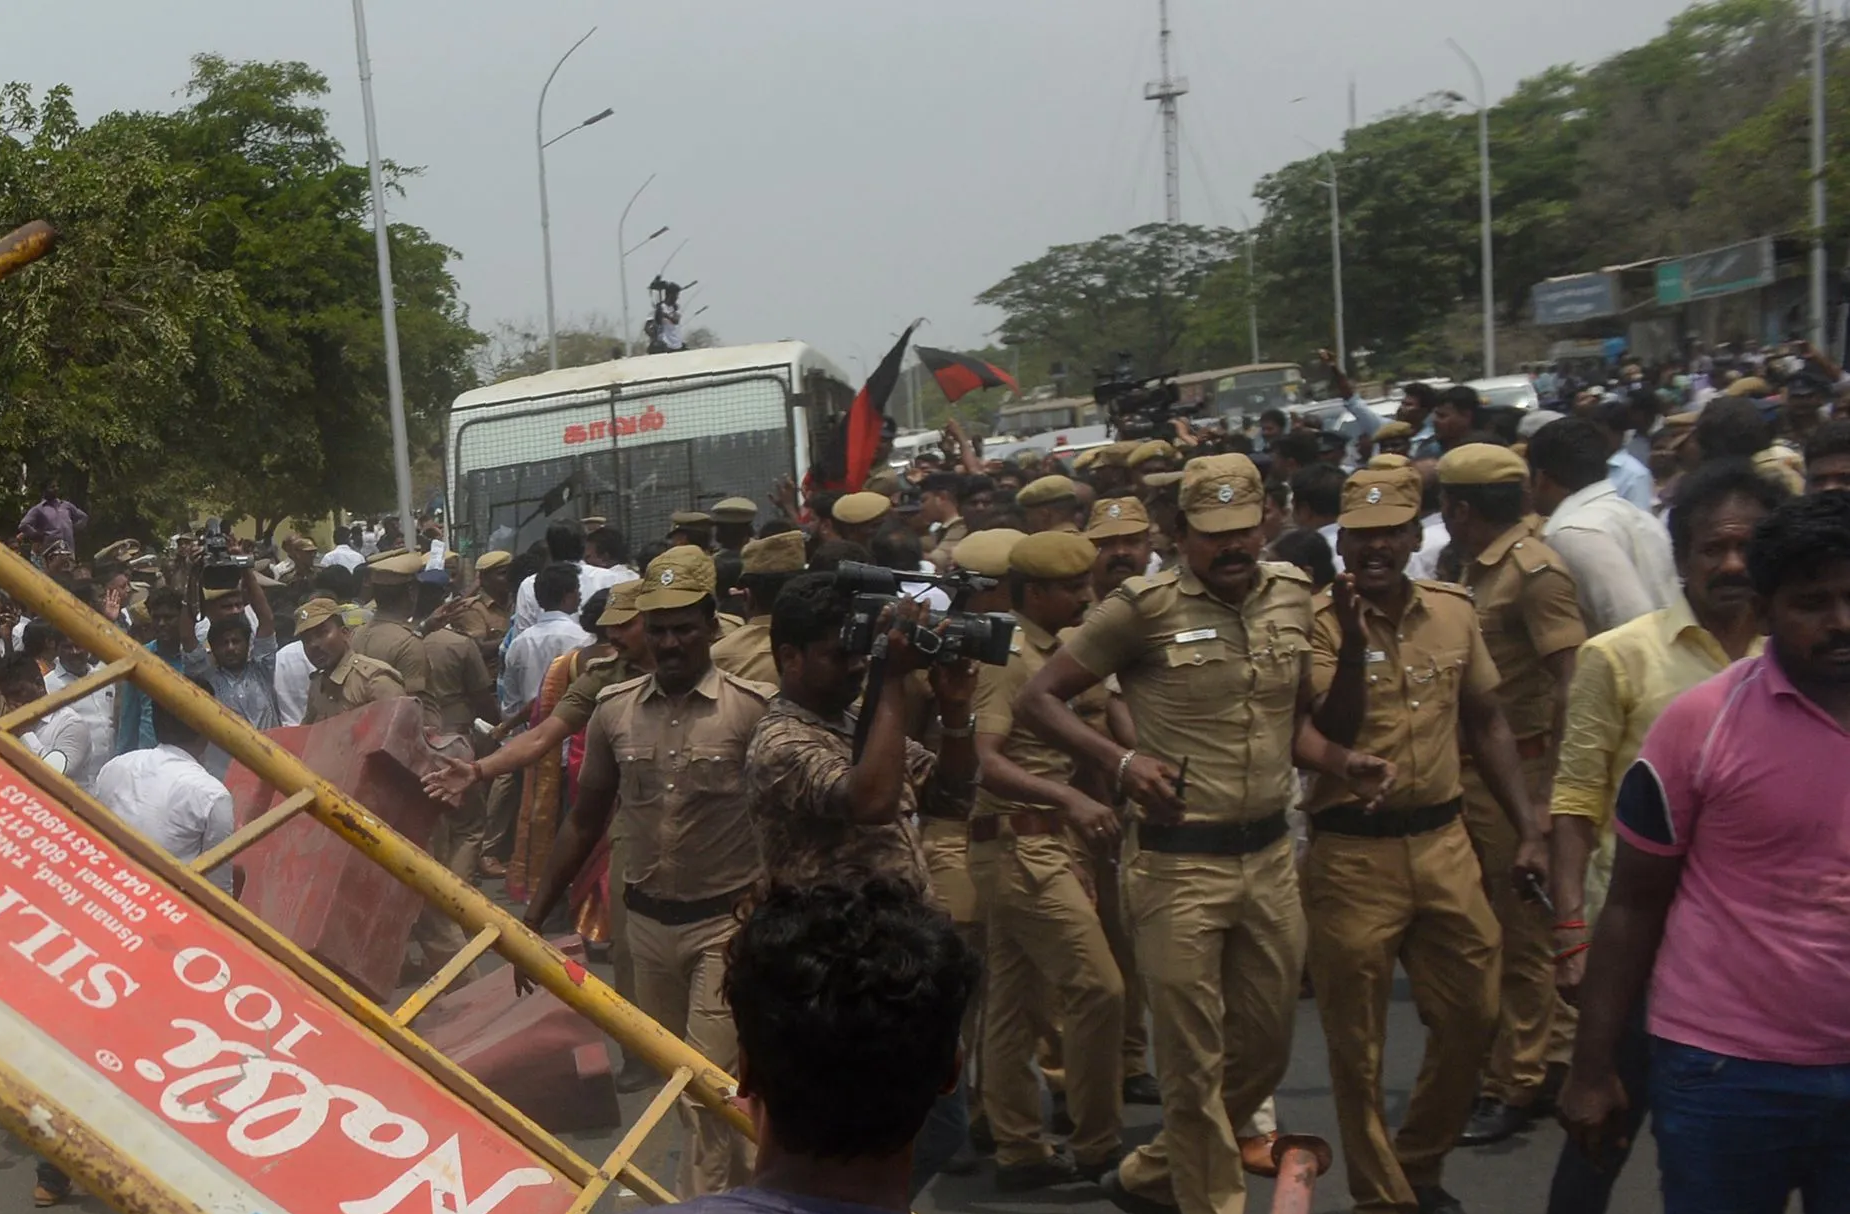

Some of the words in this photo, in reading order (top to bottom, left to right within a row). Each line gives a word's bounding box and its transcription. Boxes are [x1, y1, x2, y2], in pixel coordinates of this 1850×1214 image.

[563, 404, 665, 444] காவல்
[31, 836, 67, 863] 600
[33, 863, 84, 906] Road,
[74, 867, 147, 922] Chennai
[113, 870, 150, 896] 044
[82, 901, 143, 952] Usman
[156, 900, 187, 924] PH
[173, 947, 322, 1071] 100
